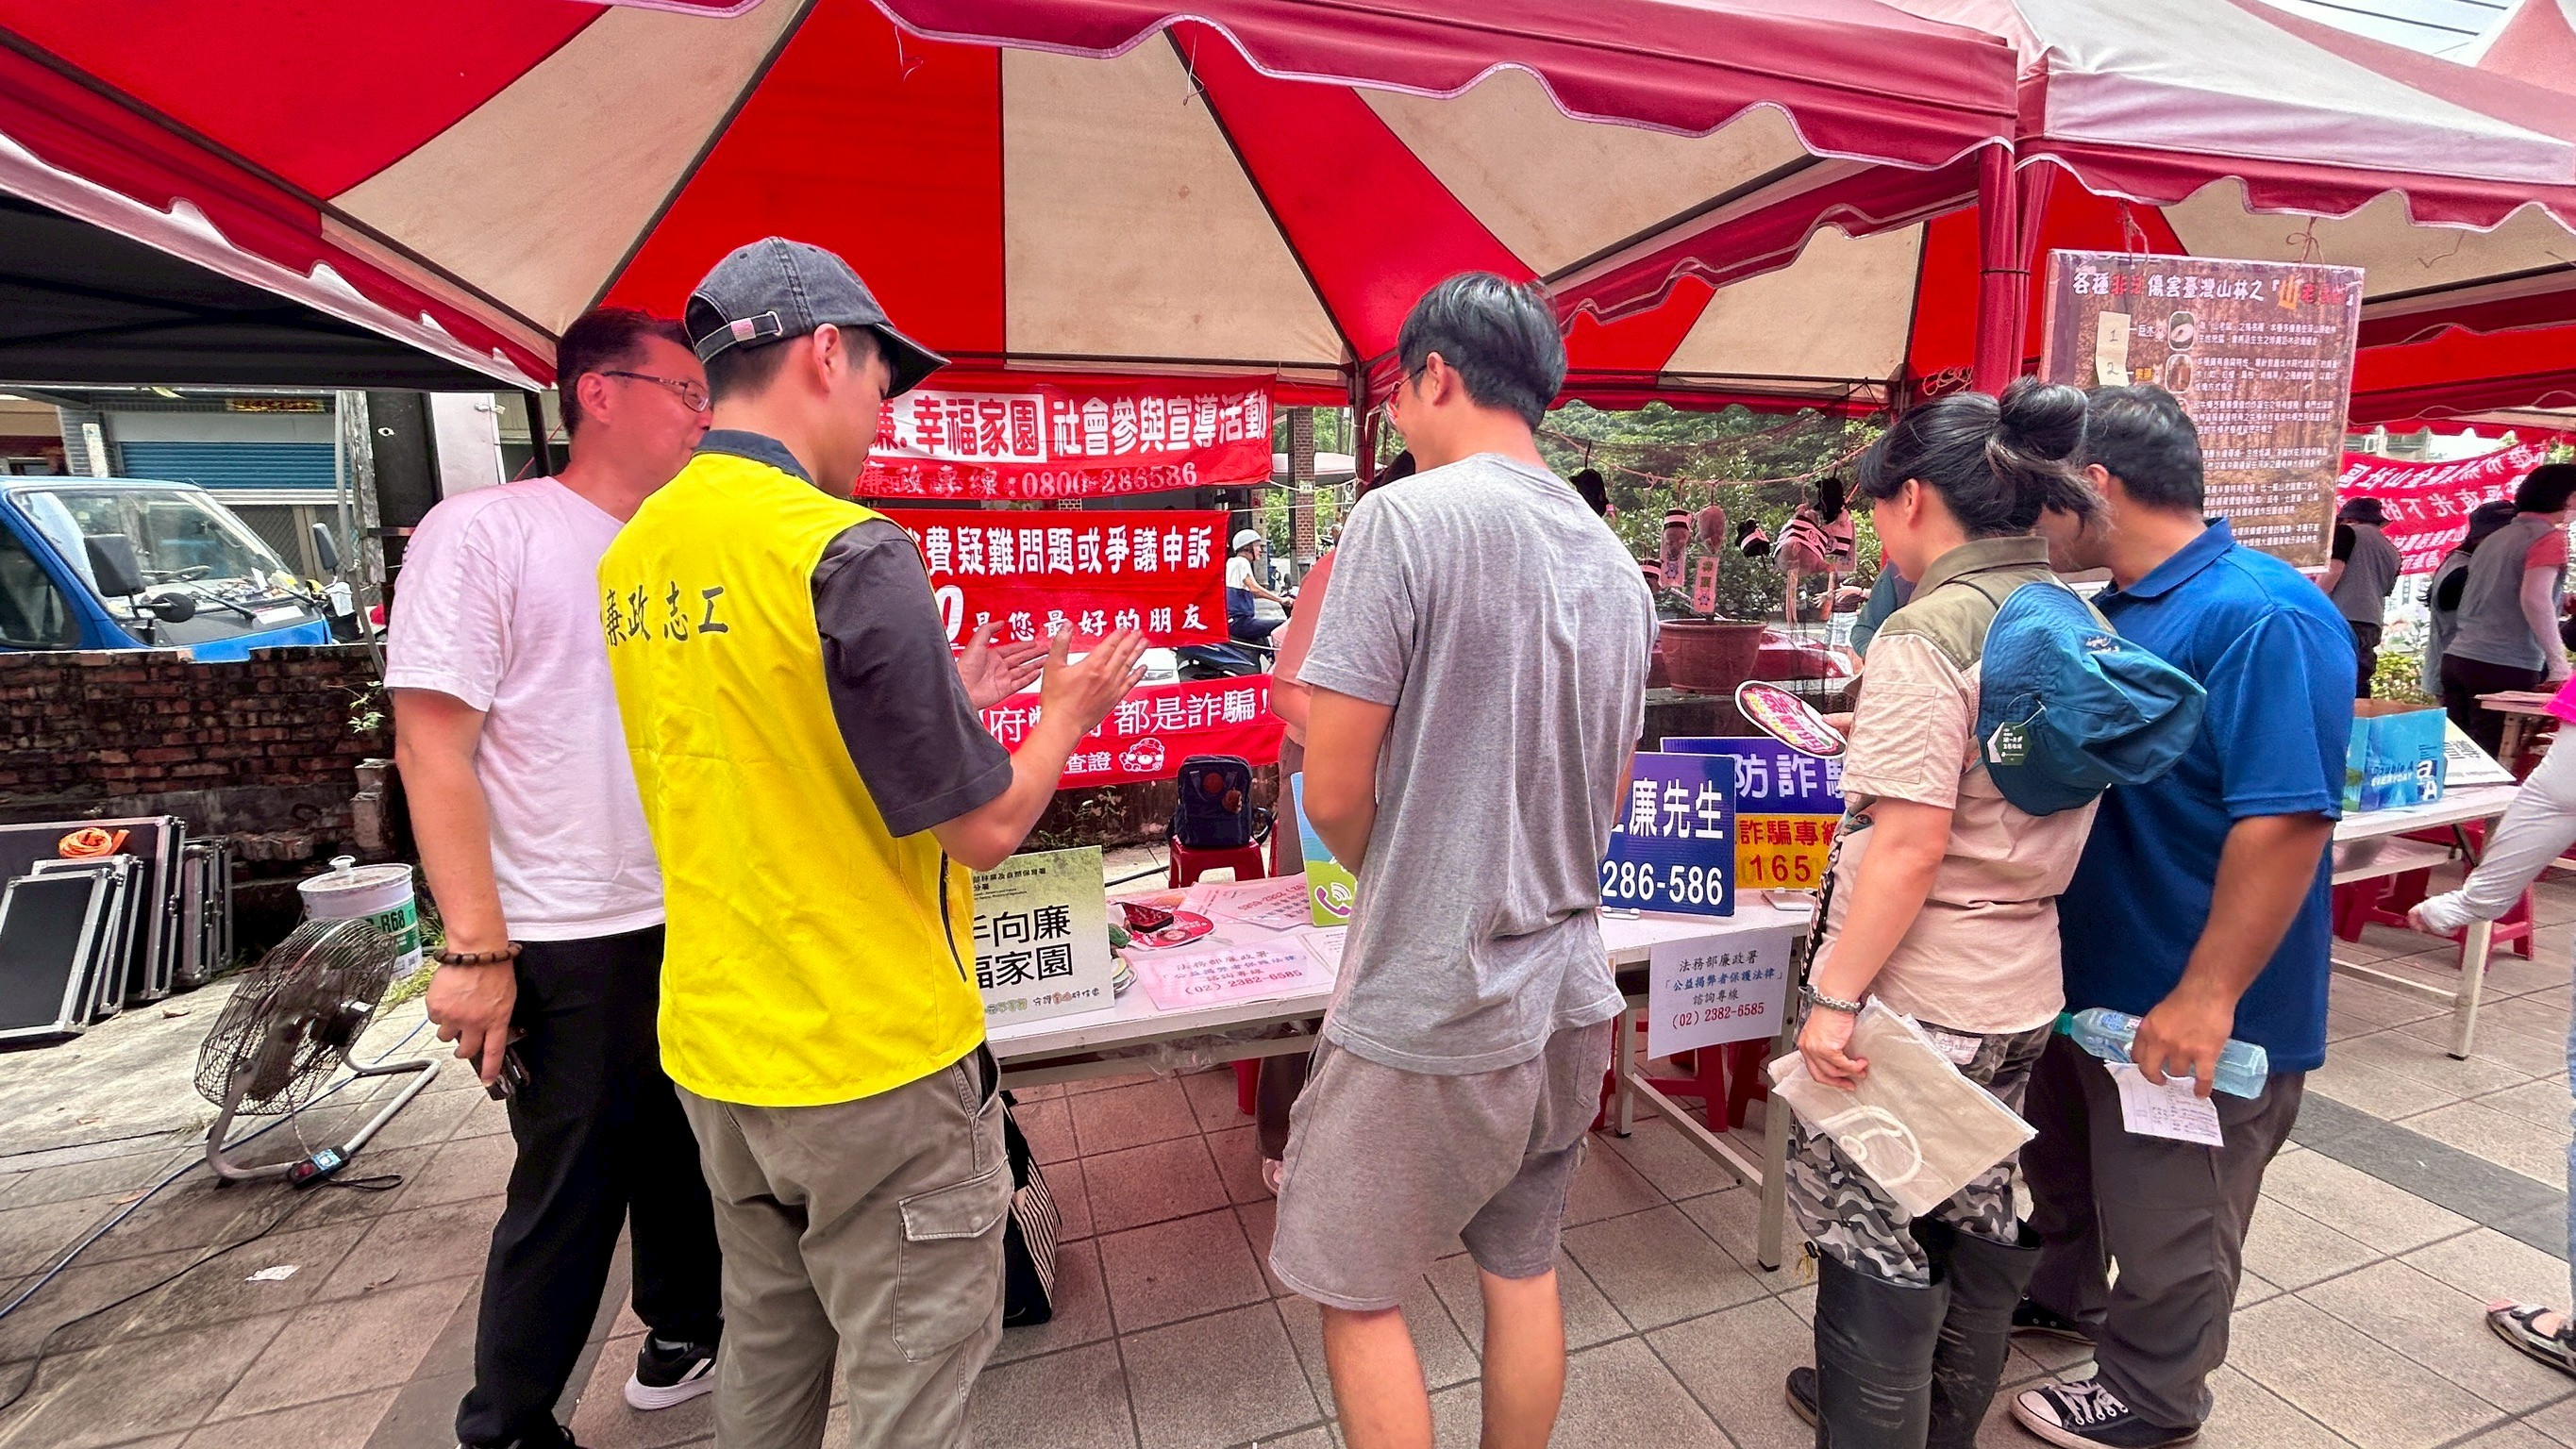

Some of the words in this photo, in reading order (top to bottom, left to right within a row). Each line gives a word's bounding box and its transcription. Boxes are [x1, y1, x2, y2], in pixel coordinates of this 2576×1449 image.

[2107, 361, 2119, 375] 2
[1052, 388, 1267, 457] 社會參與宣導活動
[912, 525, 1212, 576] 費疑難問題或爭議申訴
[601, 580, 728, 646] 廉政志工
[1611, 776, 1724, 839] 廉先生
[1603, 860, 1723, 906] 286-586
[1749, 854, 1811, 882] 165
[1679, 949, 1759, 972] 法務部廉政署
